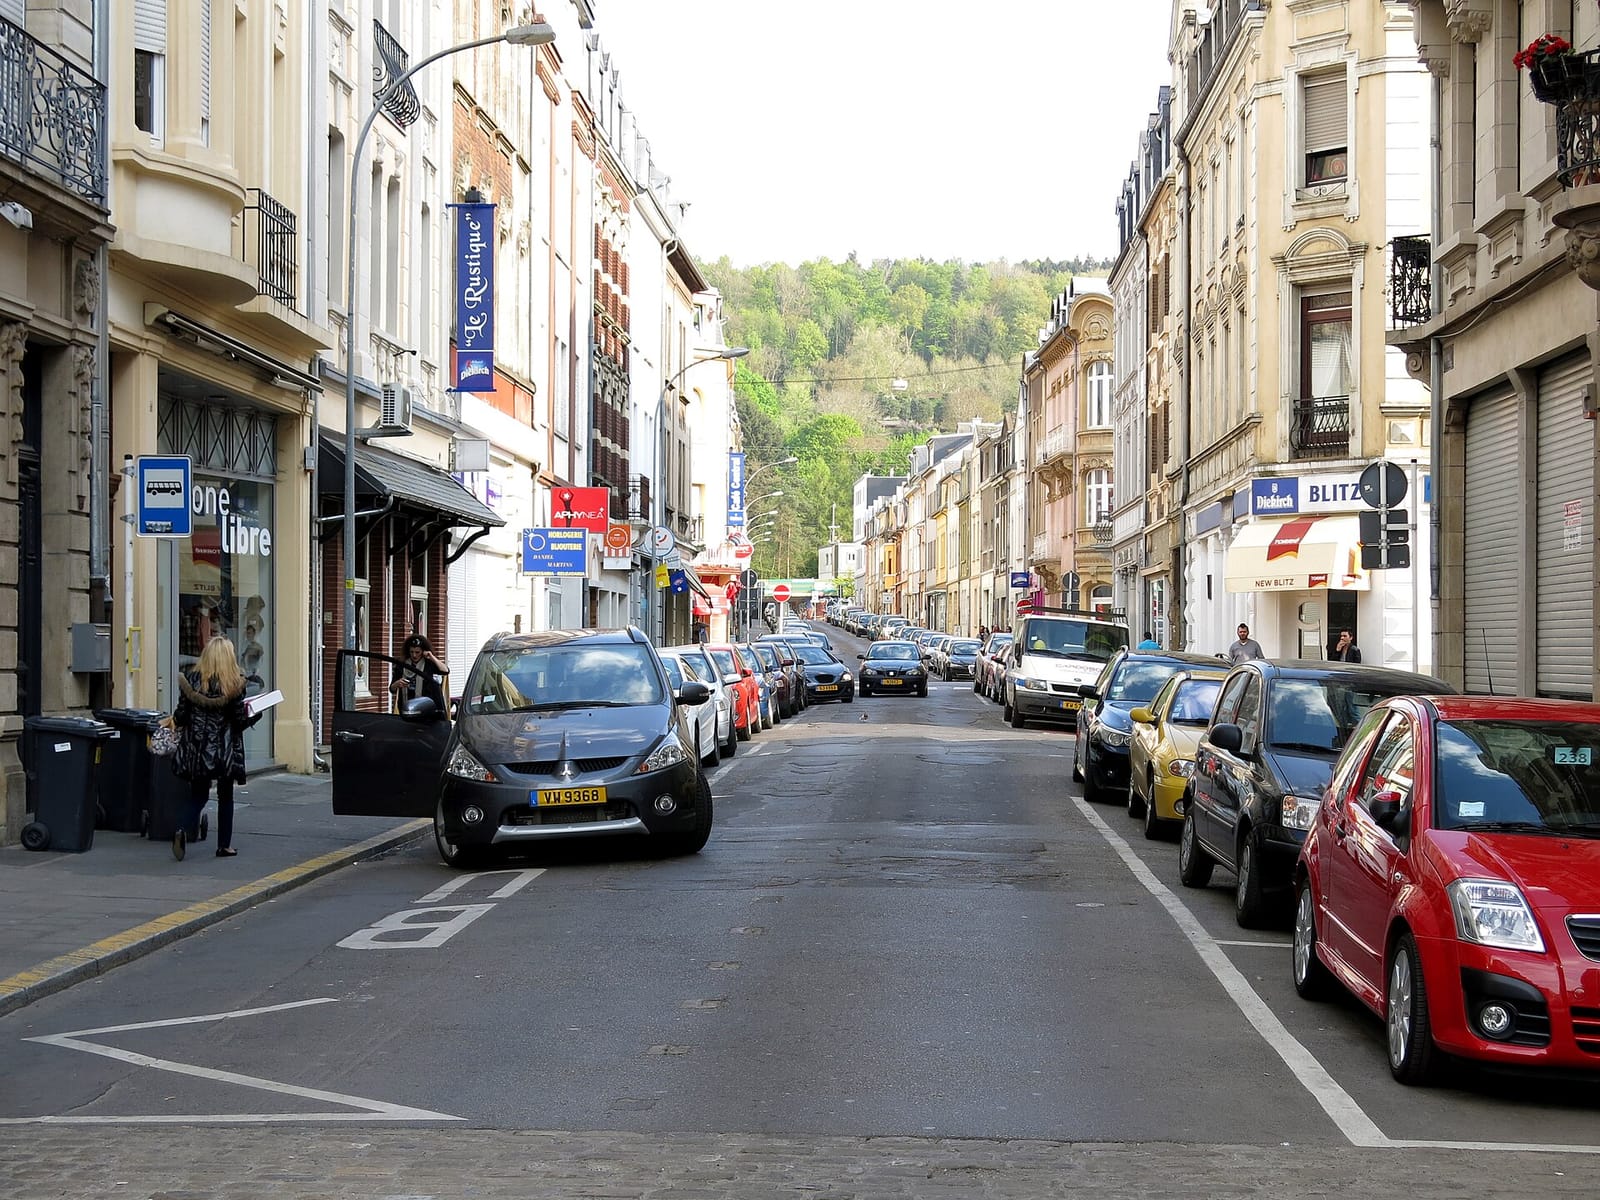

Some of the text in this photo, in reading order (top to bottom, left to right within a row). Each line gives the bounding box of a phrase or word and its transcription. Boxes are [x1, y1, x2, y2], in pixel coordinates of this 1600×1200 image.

[1256, 482, 1361, 510] Diekirch BLITZ
[221, 515, 272, 556] libre
[547, 531, 584, 539] HORLOGERIE
[550, 543, 583, 551] BIJOUTERIE
[1254, 578, 1295, 588] NEW BLITZ
[1558, 753, 1588, 764] 238
[544, 791, 562, 804] VW
[564, 789, 600, 803] 9368
